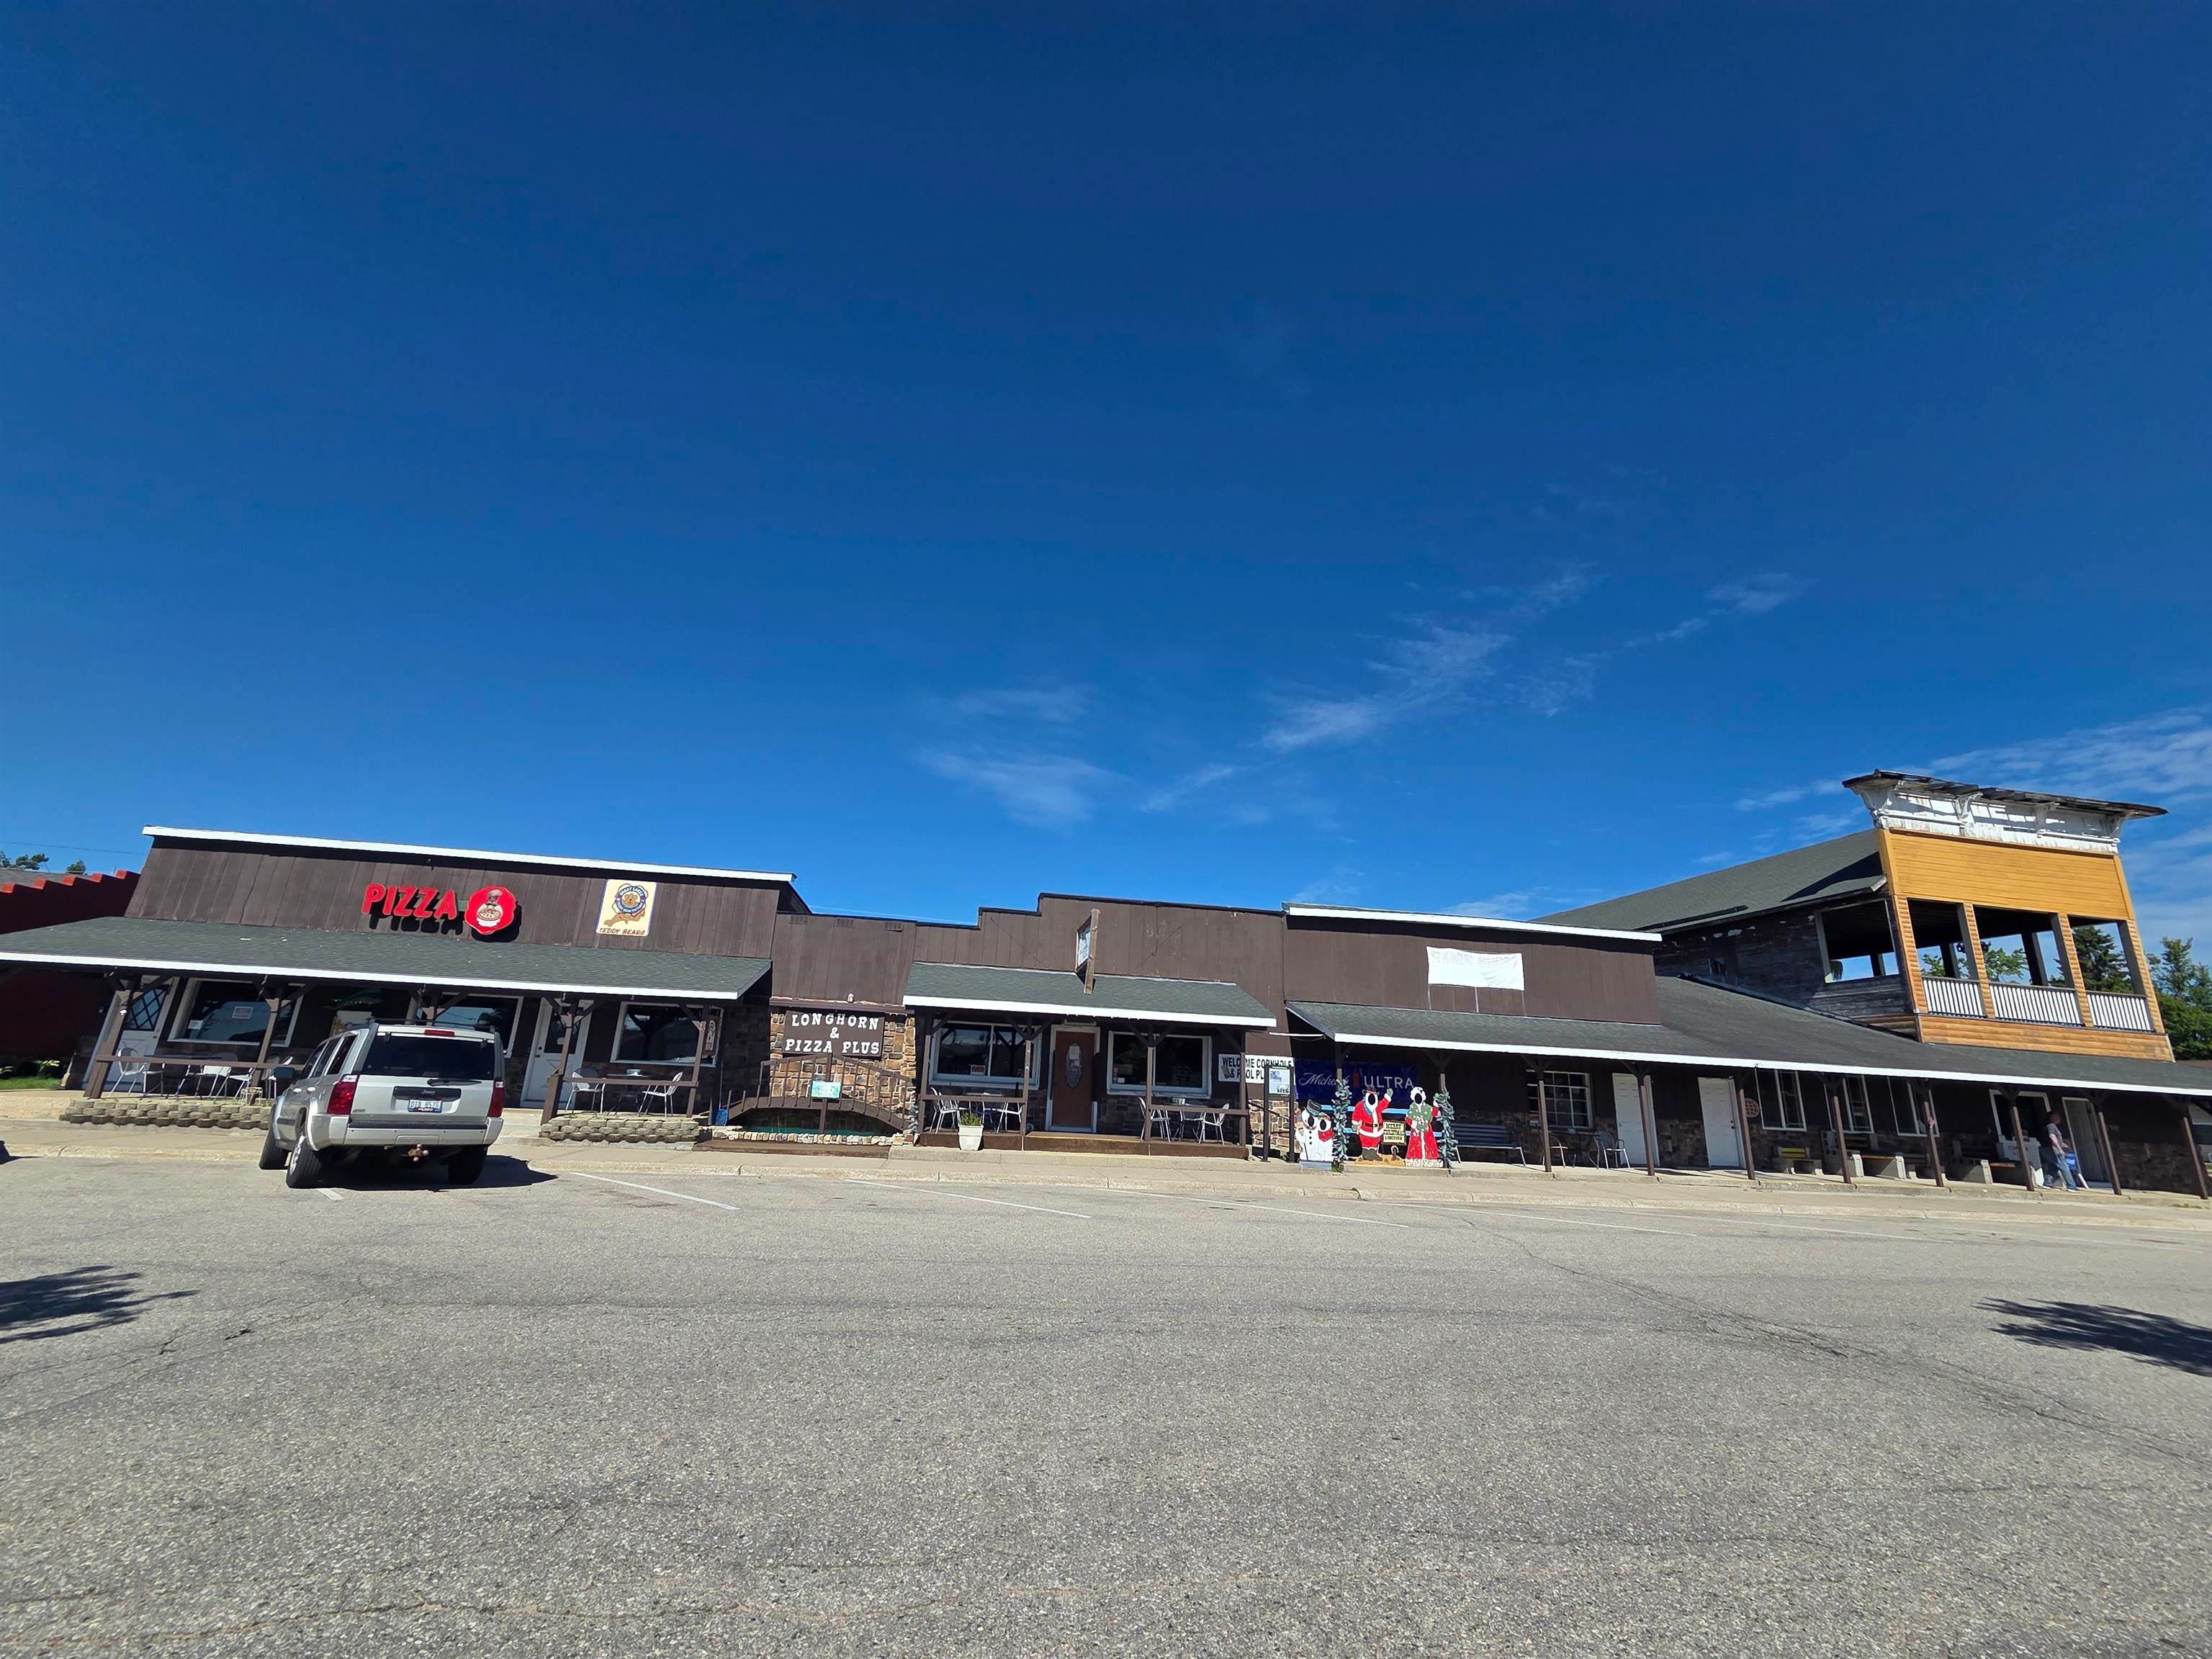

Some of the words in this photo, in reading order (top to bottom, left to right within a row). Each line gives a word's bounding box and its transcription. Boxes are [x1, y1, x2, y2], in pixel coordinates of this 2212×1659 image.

[361, 883, 457, 920] PIZZA
[791, 1012, 879, 1030] LONGHORN
[830, 1026, 840, 1039] &
[784, 1038, 833, 1053] PIZZA
[842, 1041, 879, 1054] PLUS
[1222, 1057, 1254, 1069] WELCME
[1230, 1068, 1235, 1078] &
[1237, 1069, 1254, 1079] POL
[1364, 1075, 1415, 1089] ULTRA
